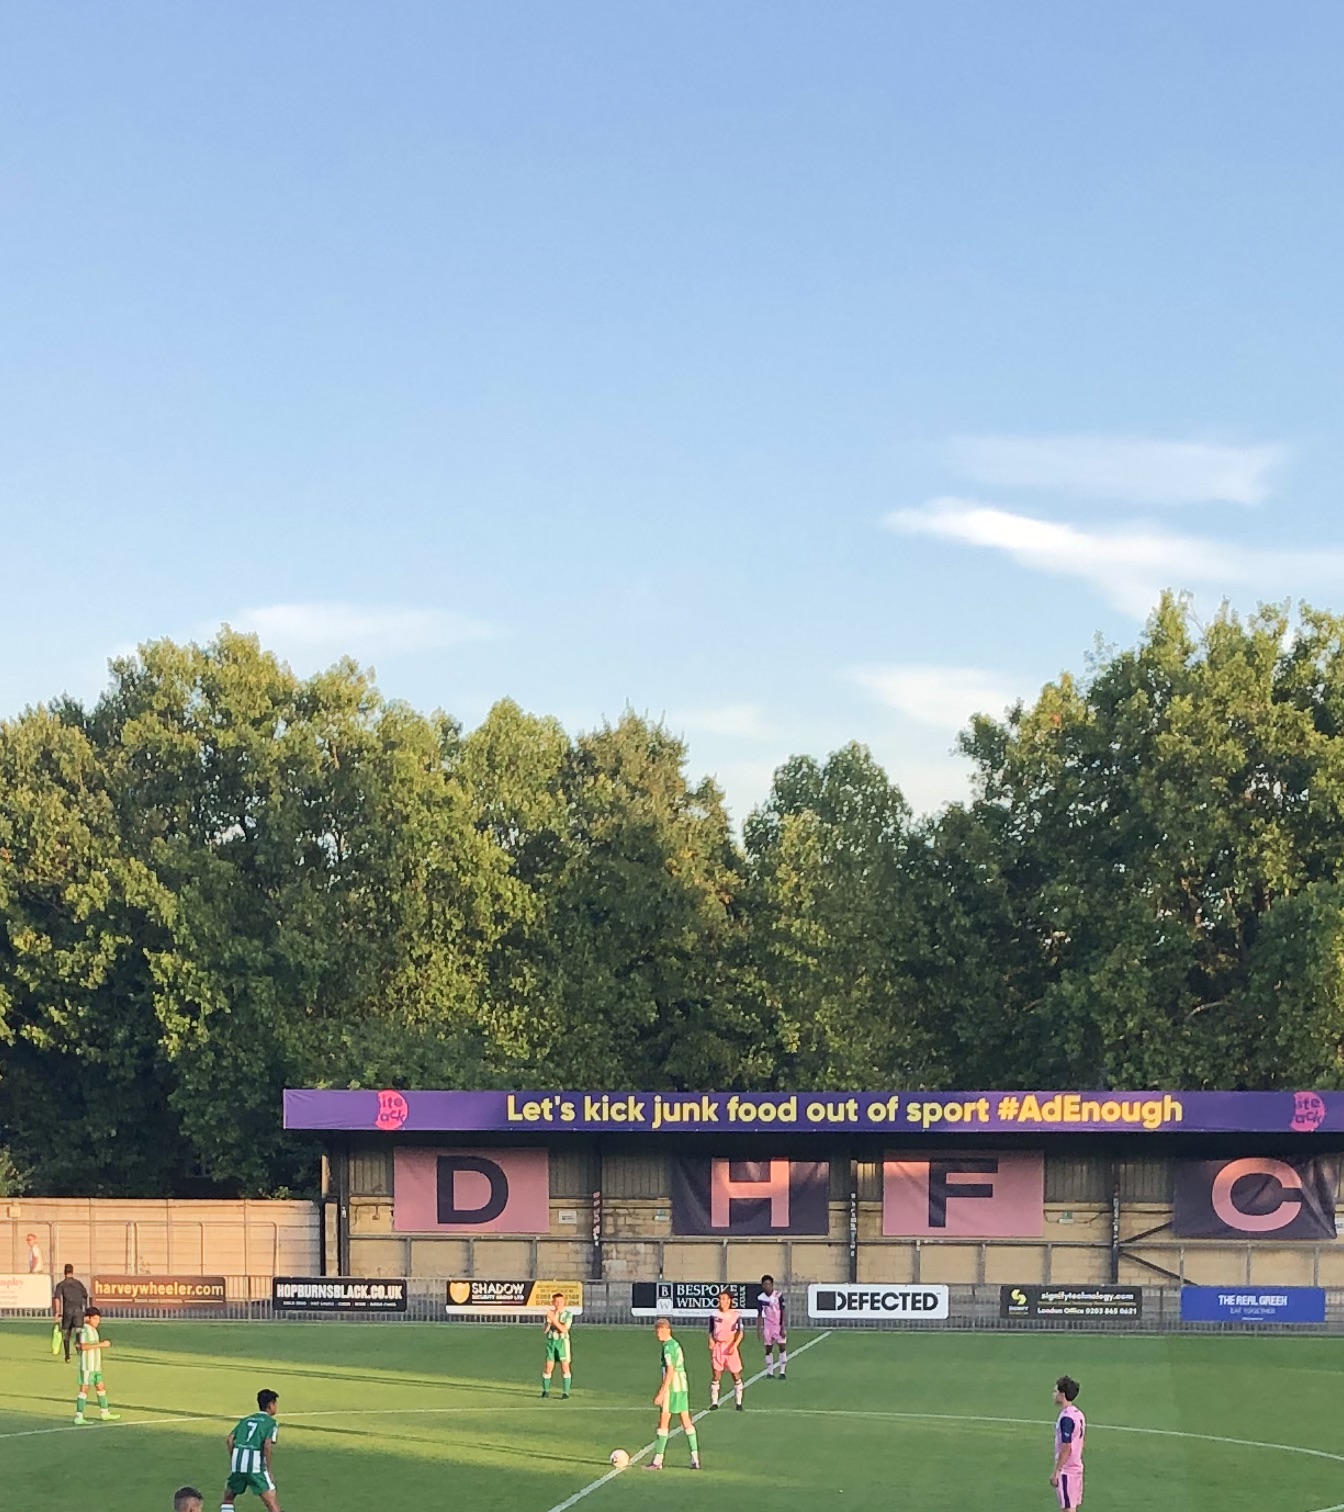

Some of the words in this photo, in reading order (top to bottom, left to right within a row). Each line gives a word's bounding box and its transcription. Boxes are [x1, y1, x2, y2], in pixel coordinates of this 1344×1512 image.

[507, 1095, 575, 1122] Let's
[584, 1095, 645, 1122] kick
[652, 1095, 719, 1129] junk
[727, 1095, 797, 1122] food
[806, 1099, 858, 1122] out
[867, 1095, 899, 1122] of
[906, 1097, 989, 1128] sport
[997, 1094, 1183, 1129] #AdEnough
[436, 1155, 509, 1224] D
[711, 1157, 790, 1228] H
[928, 1158, 999, 1228] F
[1212, 1157, 1303, 1232] C
[95, 1280, 224, 1297] harveywheeler.com
[276, 1283, 403, 1299] HOPBURNSBLACK.CO.UK
[472, 1282, 525, 1295] SHADOW
[676, 1284, 738, 1297] BESPOKE
[676, 1297, 739, 1309] WINDOS
[837, 1291, 939, 1311] DEFECTED
[1218, 1294, 1235, 1306] THE
[1236, 1295, 1258, 1306] REAL
[1259, 1295, 1288, 1306] GREEK
[246, 1421, 258, 1442] 7
